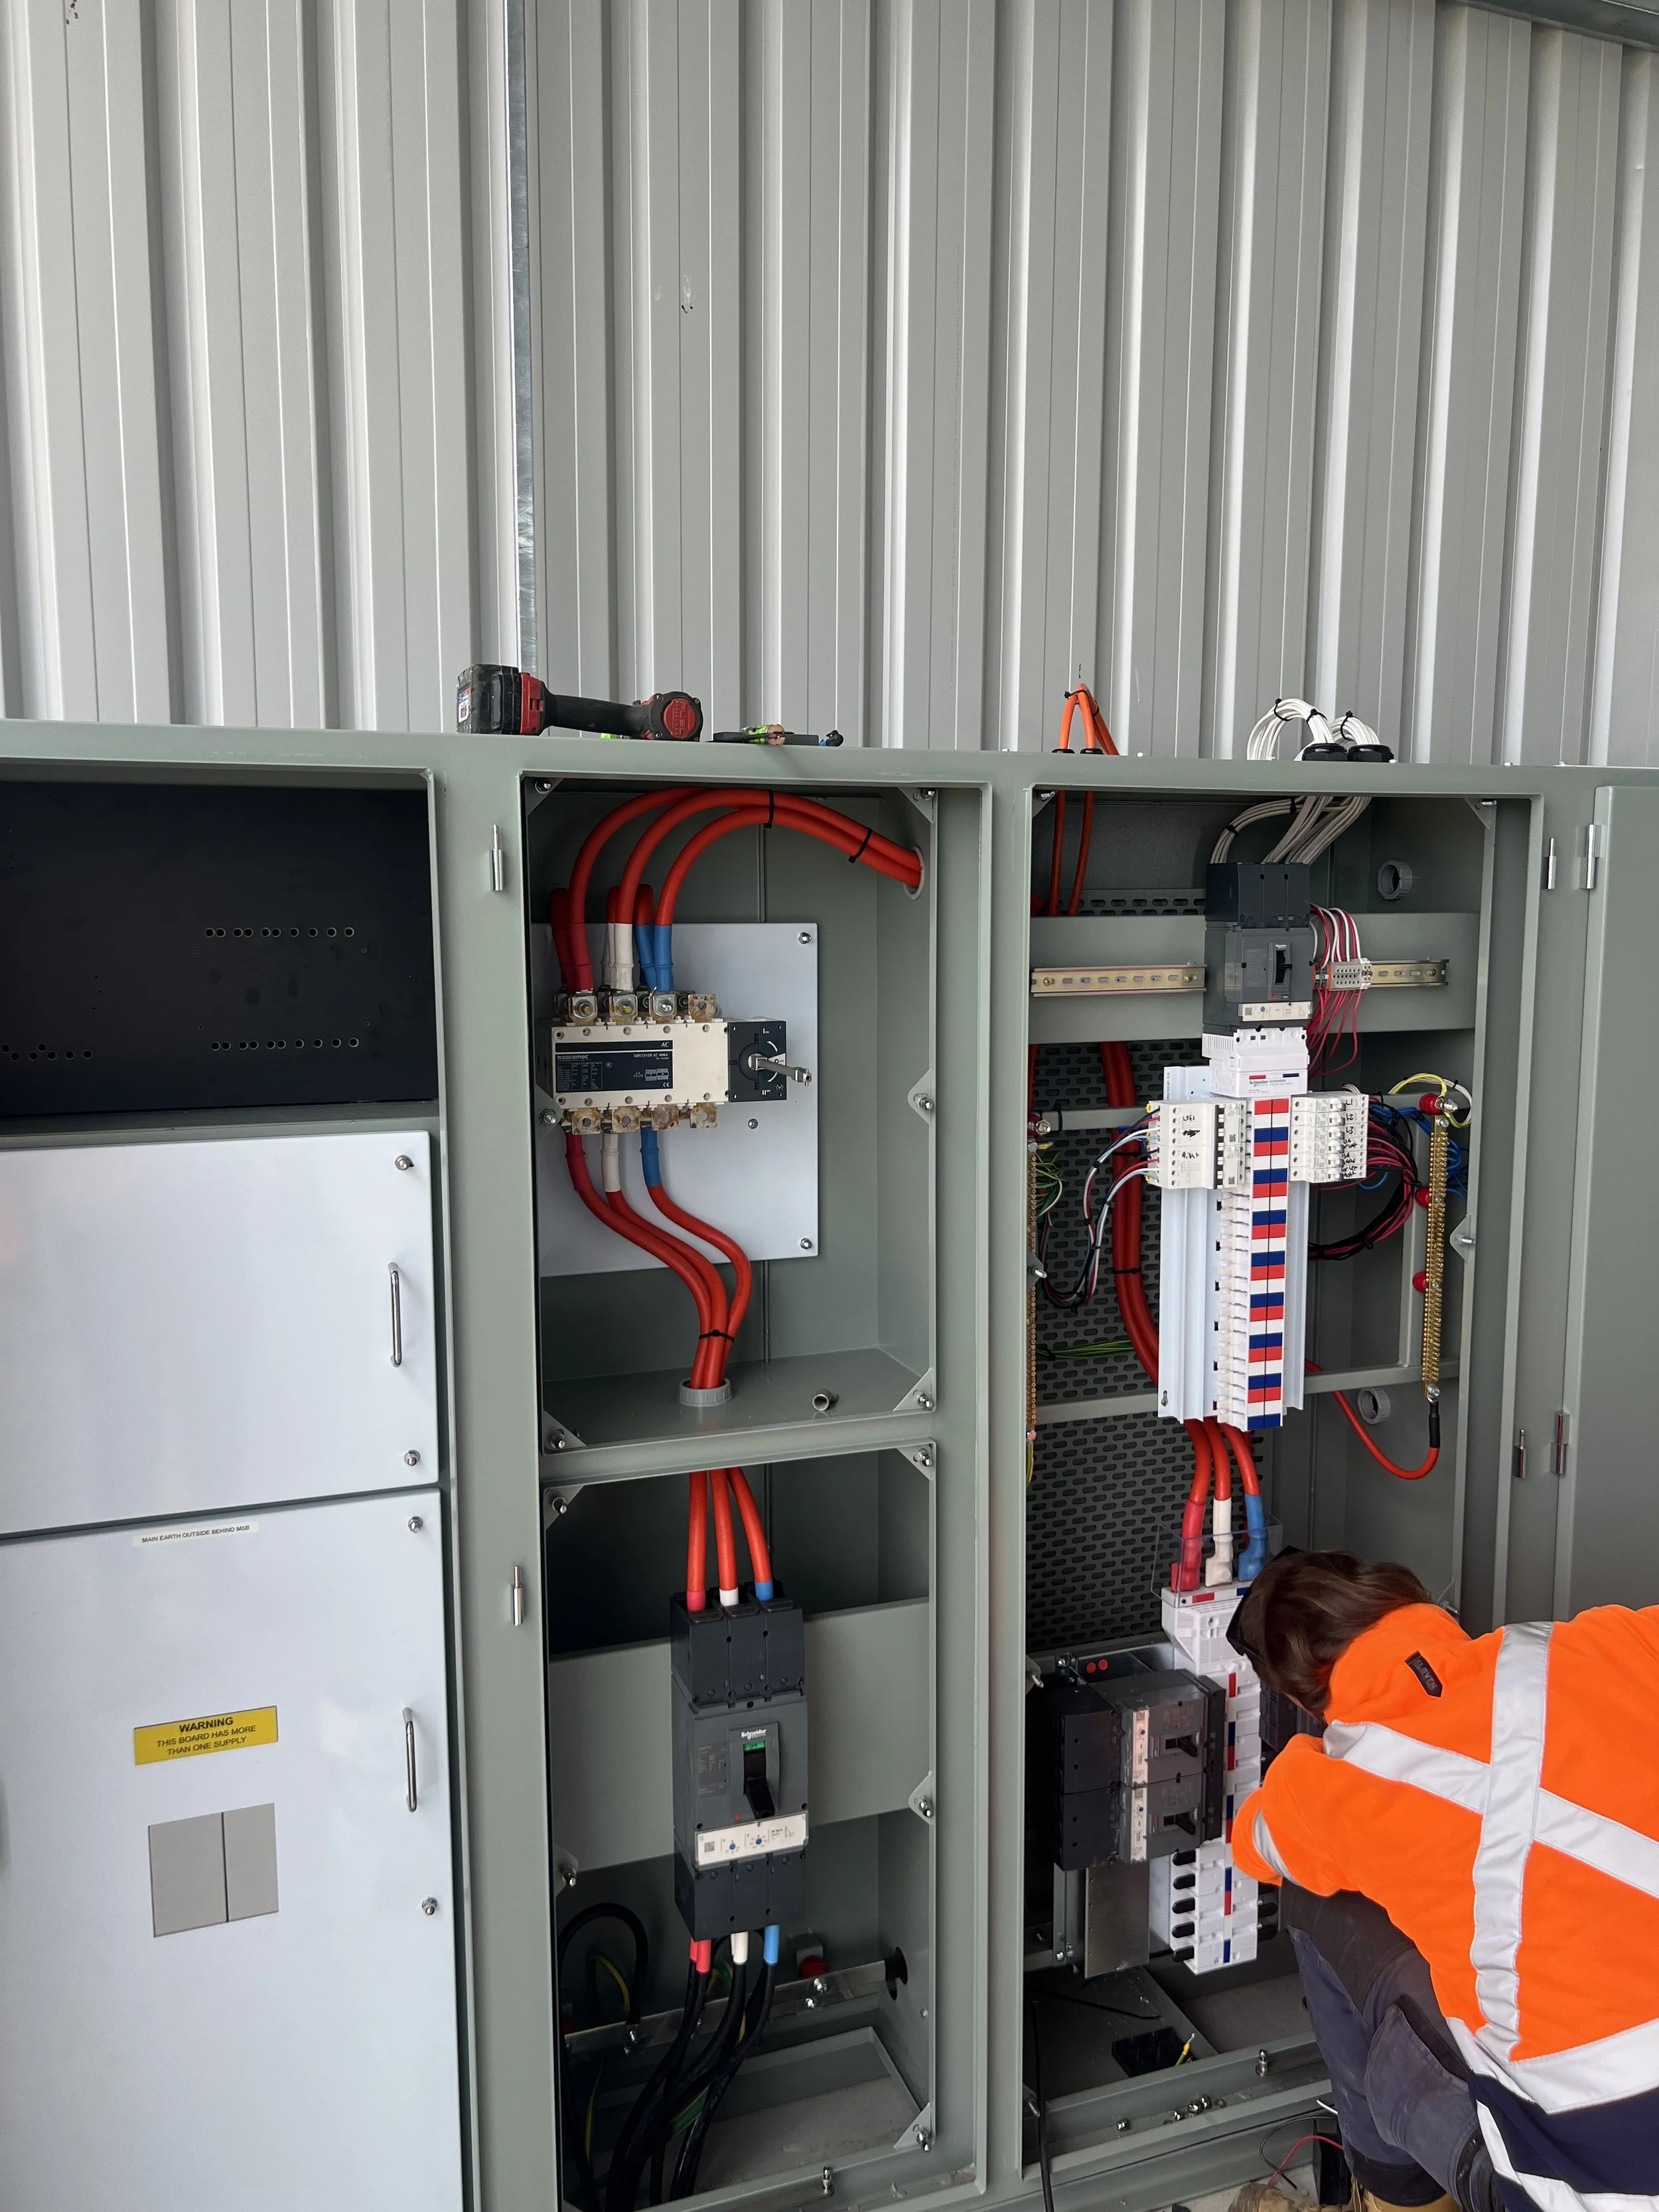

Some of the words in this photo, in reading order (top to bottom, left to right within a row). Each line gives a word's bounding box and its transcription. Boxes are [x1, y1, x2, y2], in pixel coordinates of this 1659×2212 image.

[179, 1717, 234, 1733] WARNING
[157, 1738, 177, 1747] THIS
[179, 1733, 209, 1743] BOARD
[212, 1730, 230, 1738] HAS
[232, 1725, 257, 1735] MORE
[167, 1745, 191, 1755] THAN
[214, 1736, 247, 1747] SUPPLY
